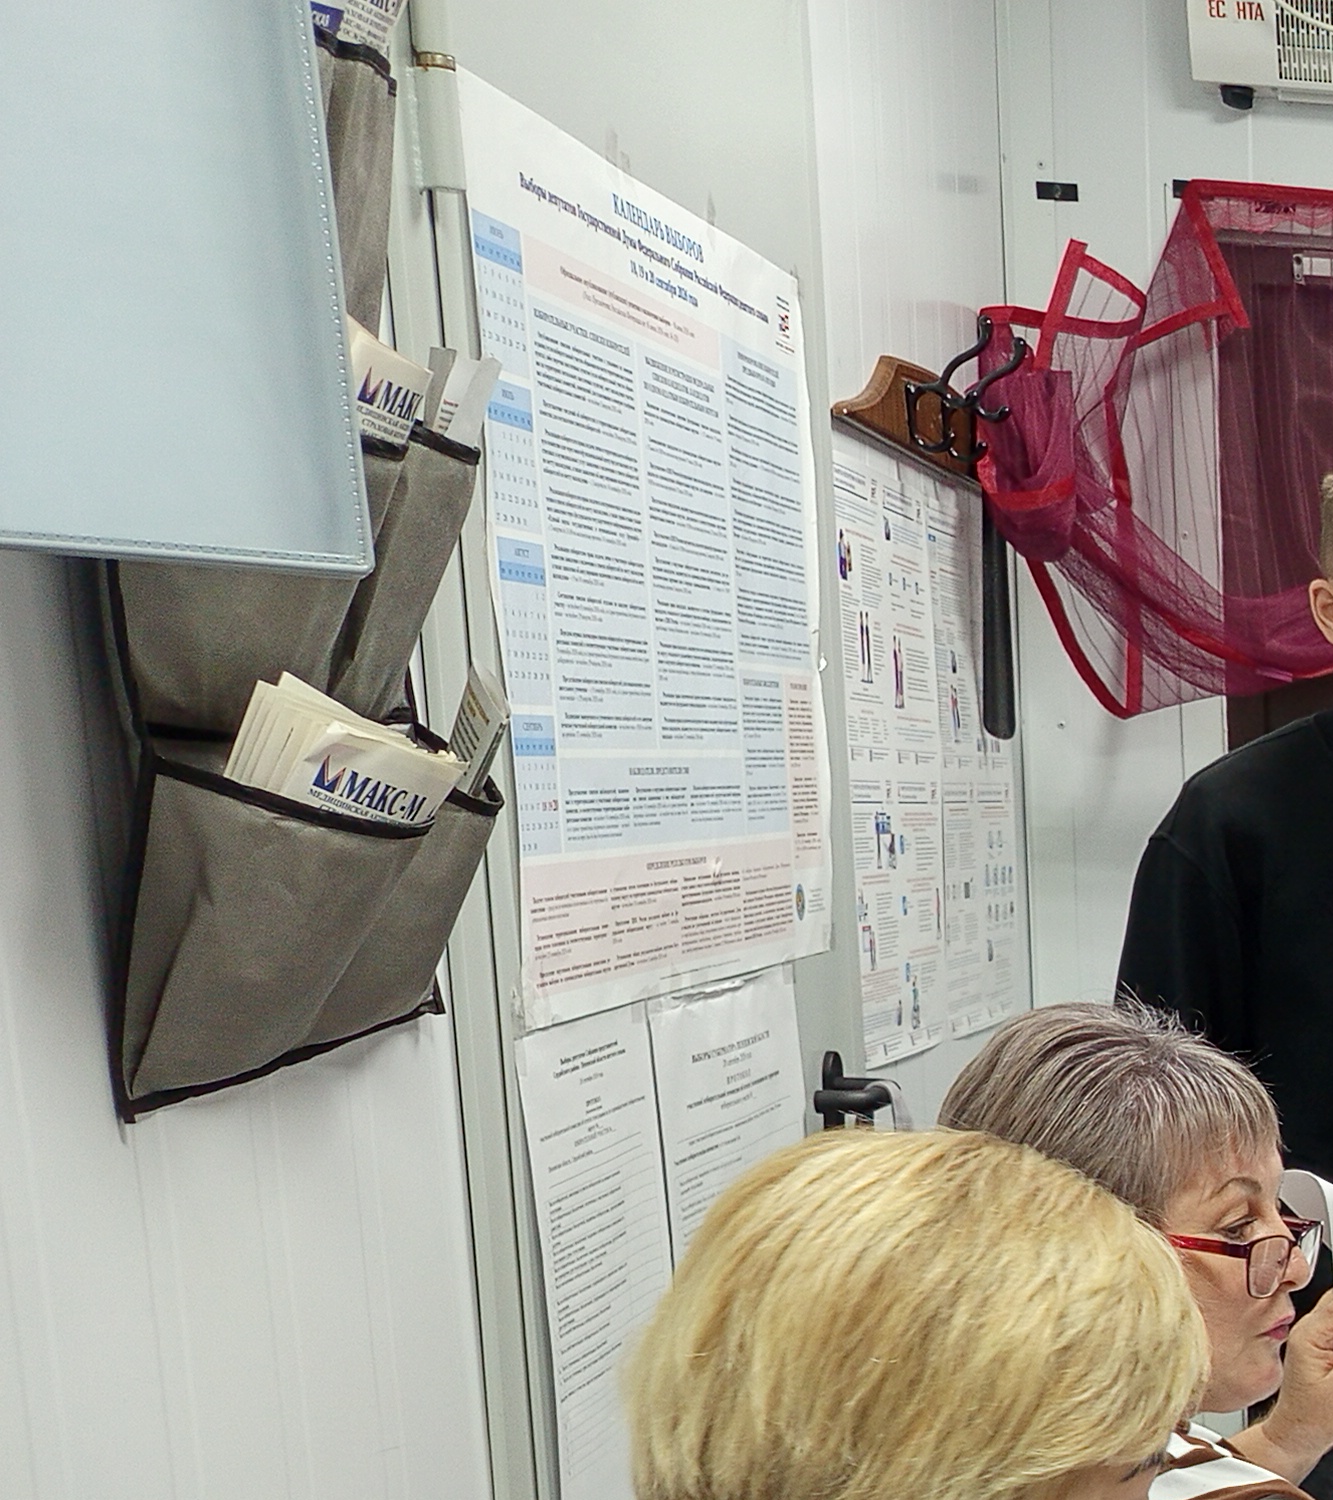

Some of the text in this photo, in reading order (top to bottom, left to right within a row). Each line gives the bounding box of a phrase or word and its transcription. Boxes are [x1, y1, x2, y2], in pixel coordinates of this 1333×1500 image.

[519, 171, 547, 201] Выборы
[612, 193, 704, 263] КАЛЕНДАРЬ ВЫБОРОВ
[307, 788, 370, 819] МЕДИЦИНСКАЯ
[339, 770, 427, 821] МАКС-М
